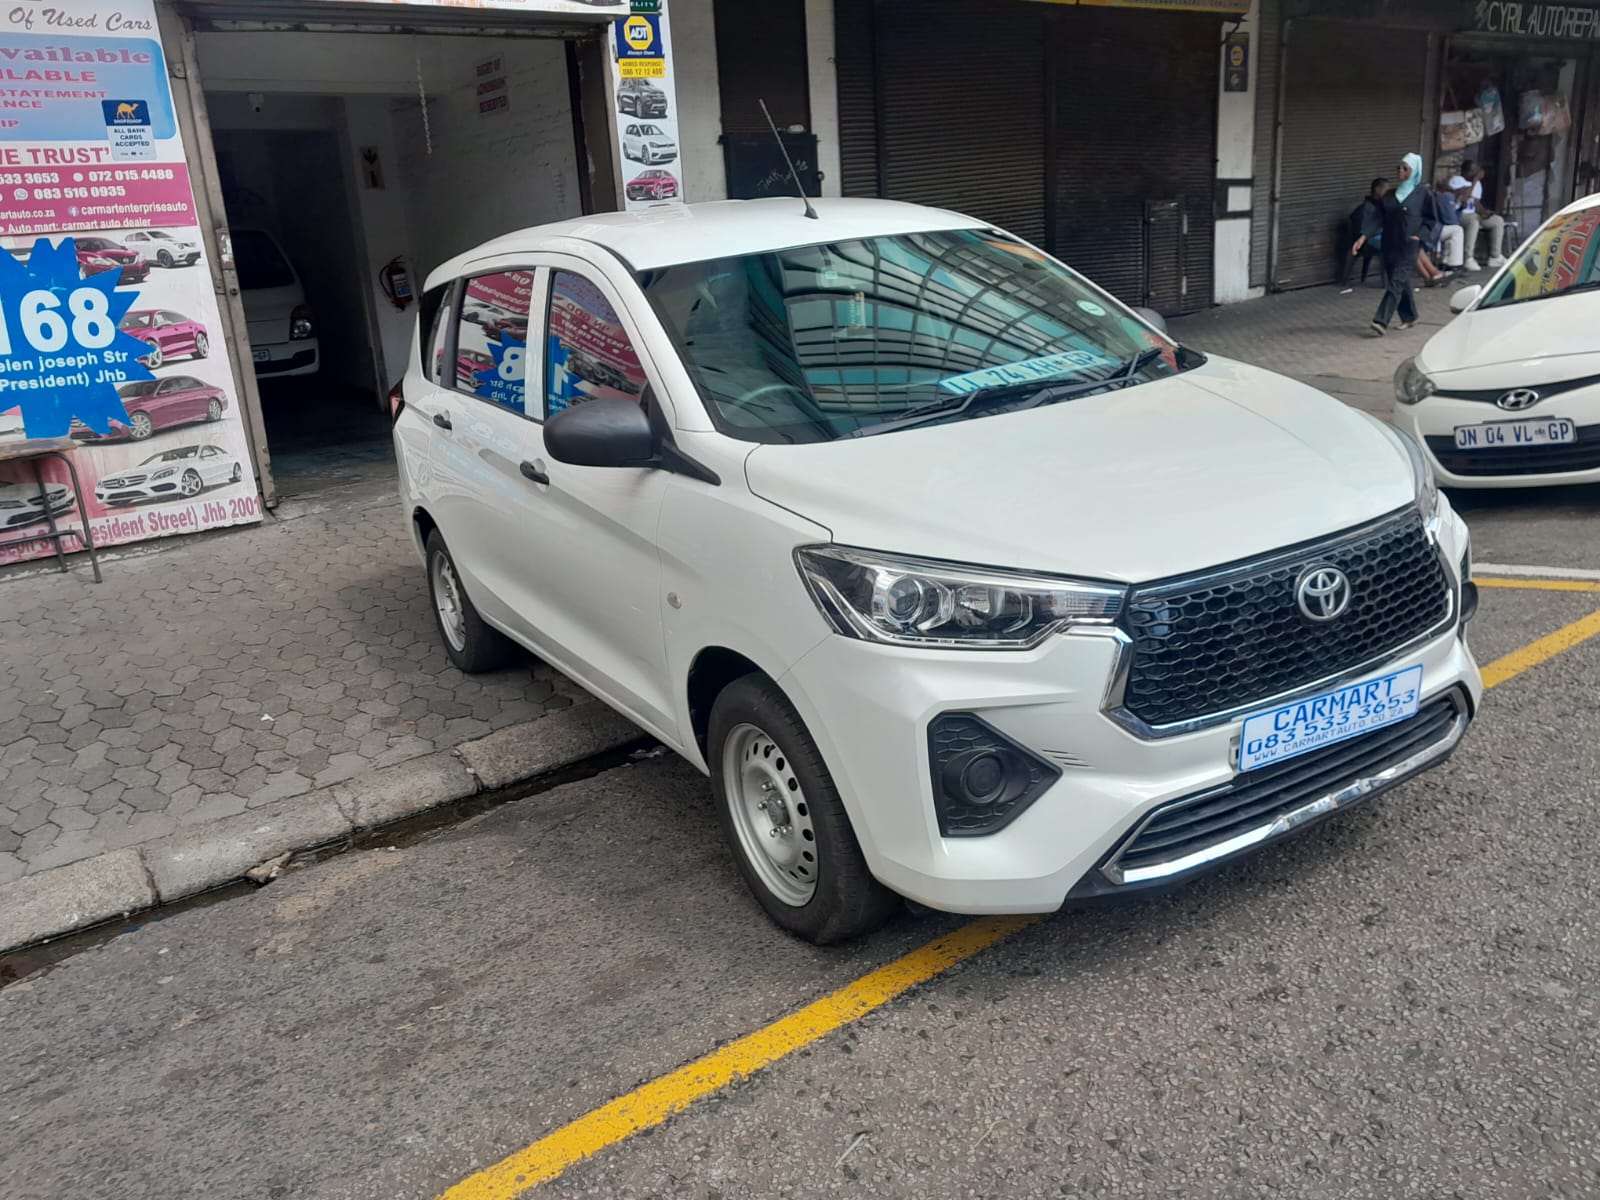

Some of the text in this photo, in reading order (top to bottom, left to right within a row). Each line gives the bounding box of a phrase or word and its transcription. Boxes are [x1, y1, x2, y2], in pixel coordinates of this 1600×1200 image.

[8, 6, 152, 32] Of Used Cars
[1487, 1, 1526, 34] CYRIL
[631, 27, 647, 39] ADT
[0, 100, 43, 108] NCE
[24, 172, 60, 184] 3653
[88, 170, 113, 182] 072
[81, 201, 188, 215] carmartenterpriseauto
[8, 223, 32, 234] Auto
[62, 220, 99, 230] carmart
[101, 218, 121, 228] auto
[123, 217, 151, 227] dealer
[39, 352, 98, 372] joseph
[103, 350, 128, 363] Str
[986, 369, 1025, 386] 74
[1019, 359, 1063, 376] XH
[1063, 352, 1098, 366] GP
[95, 369, 127, 383] Jhb
[1459, 422, 1569, 446] JN 04 VL GP
[148, 506, 198, 532] Street)
[202, 502, 227, 523] Jhb
[228, 495, 263, 518] 2001
[1274, 677, 1397, 732] CARMART
[1247, 689, 1415, 755] 083 533 3653
